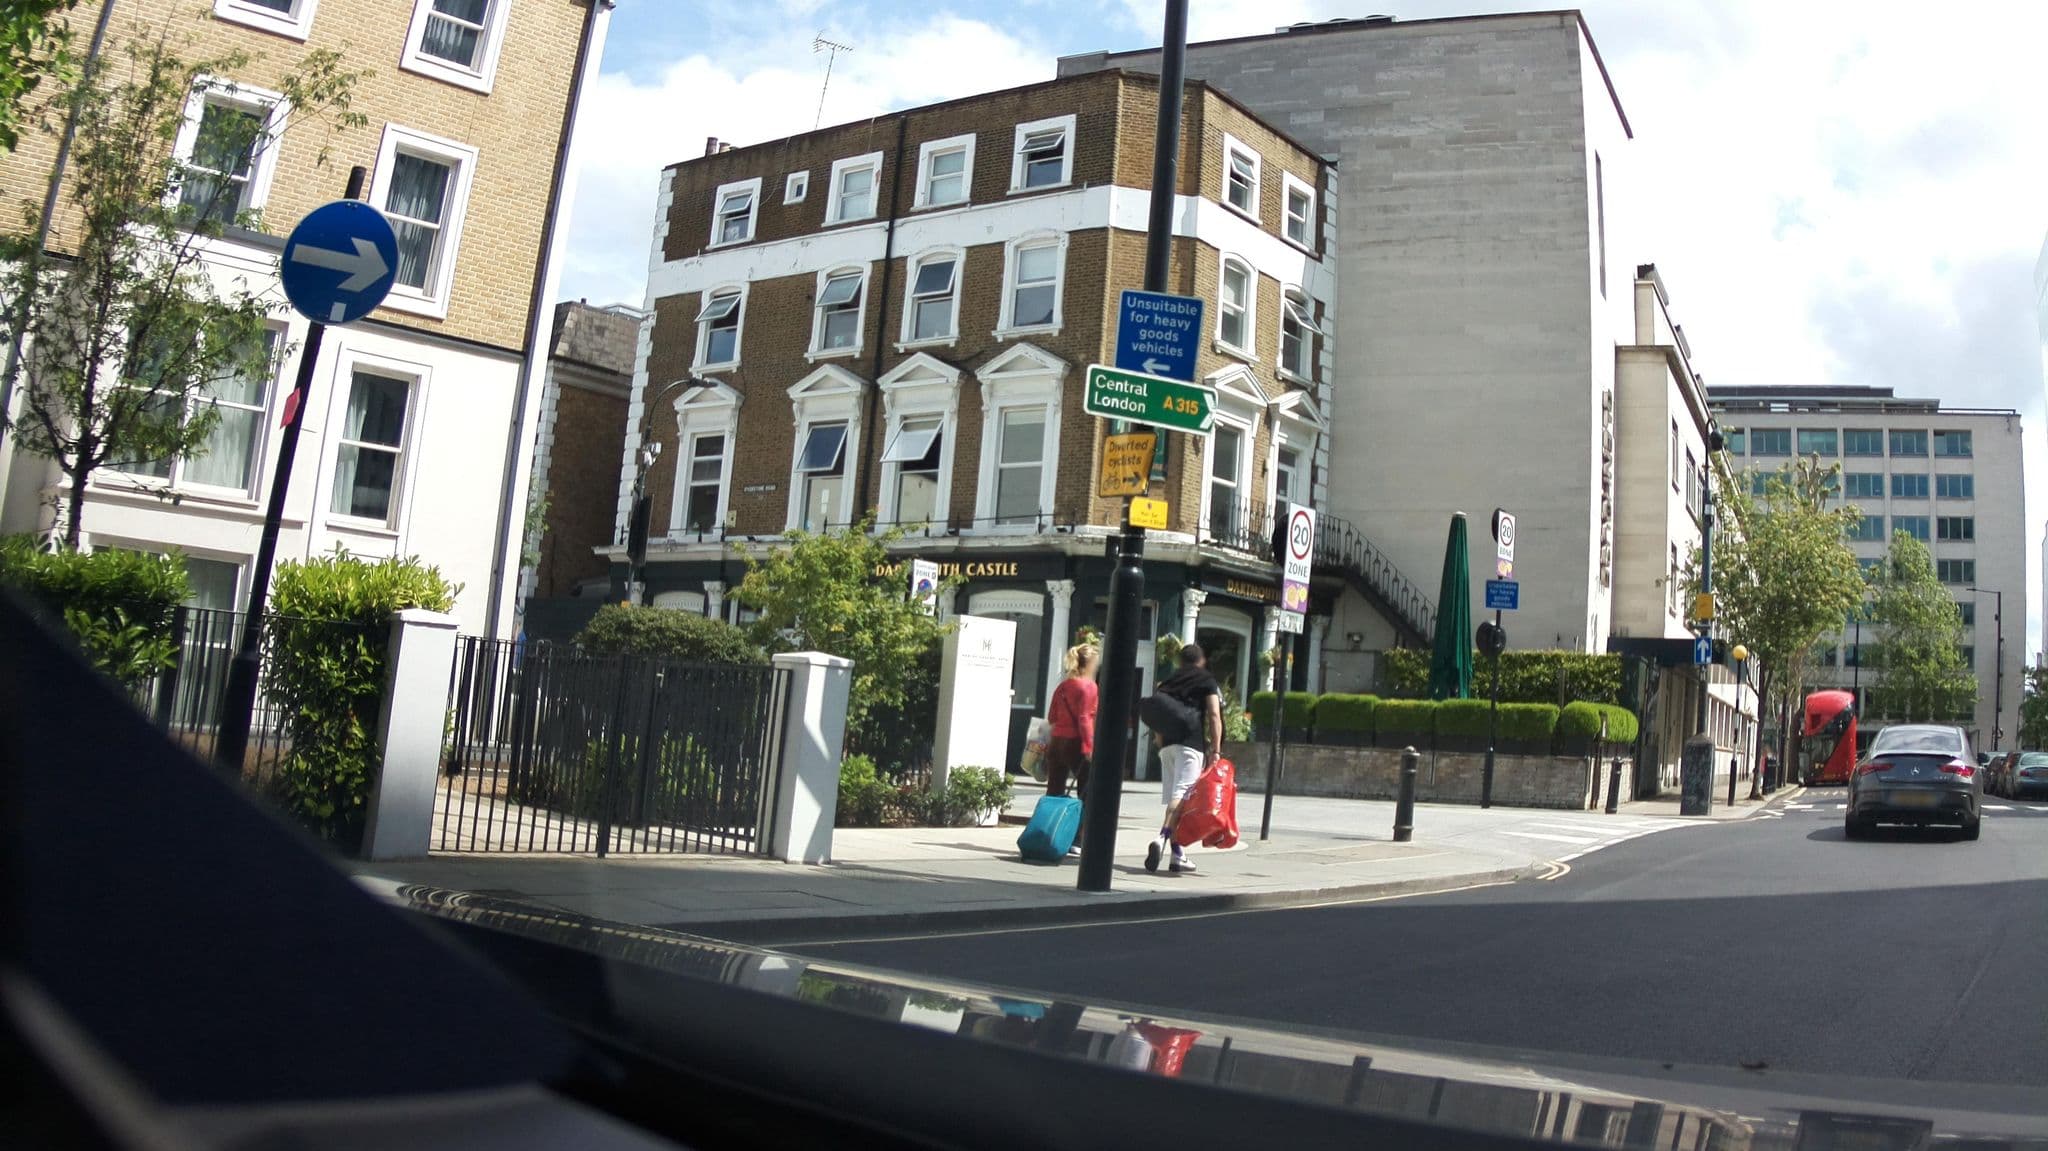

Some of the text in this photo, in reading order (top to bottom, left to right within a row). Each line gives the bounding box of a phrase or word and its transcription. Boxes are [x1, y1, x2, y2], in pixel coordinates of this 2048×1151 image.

[1126, 296, 1198, 316] Unsuitable
[1129, 311, 1191, 331] for heavy
[1139, 329, 1179, 342] goods
[1131, 342, 1183, 357] vehicles
[1095, 374, 1148, 397] Central
[1094, 391, 1199, 415] London A 315
[1294, 524, 1309, 546] 20
[1502, 525, 1512, 538] 20
[966, 562, 1018, 576] CASTLE
[1288, 561, 1308, 577] ZONE
